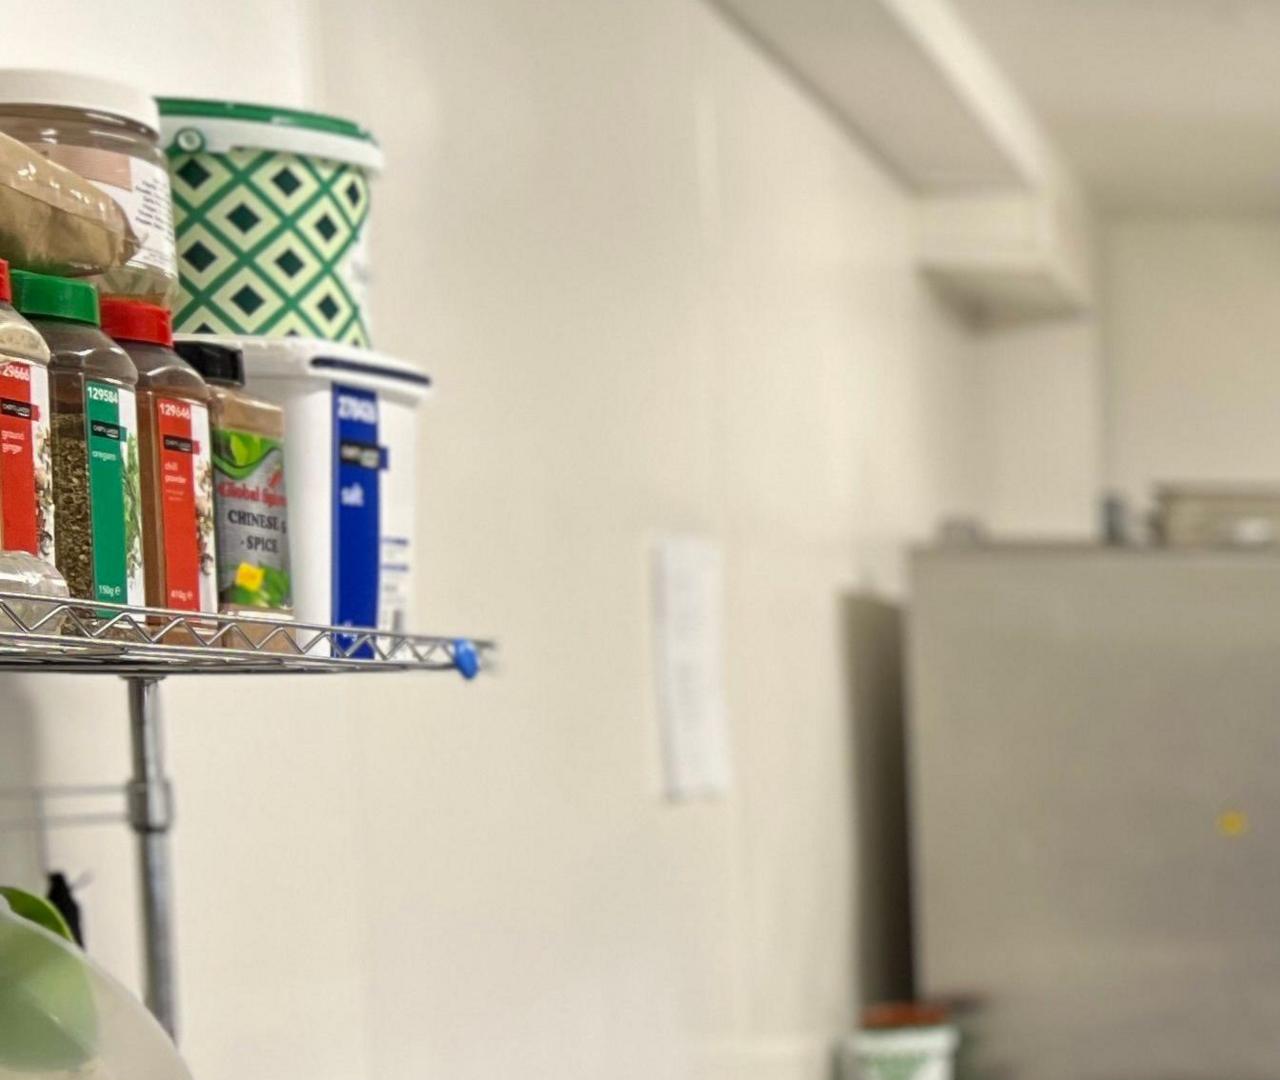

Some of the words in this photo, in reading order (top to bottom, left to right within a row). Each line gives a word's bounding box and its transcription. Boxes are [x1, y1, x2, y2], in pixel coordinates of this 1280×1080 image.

[87, 386, 119, 404] 129584
[159, 402, 191, 419] 129646
[227, 509, 279, 531] CHINESE
